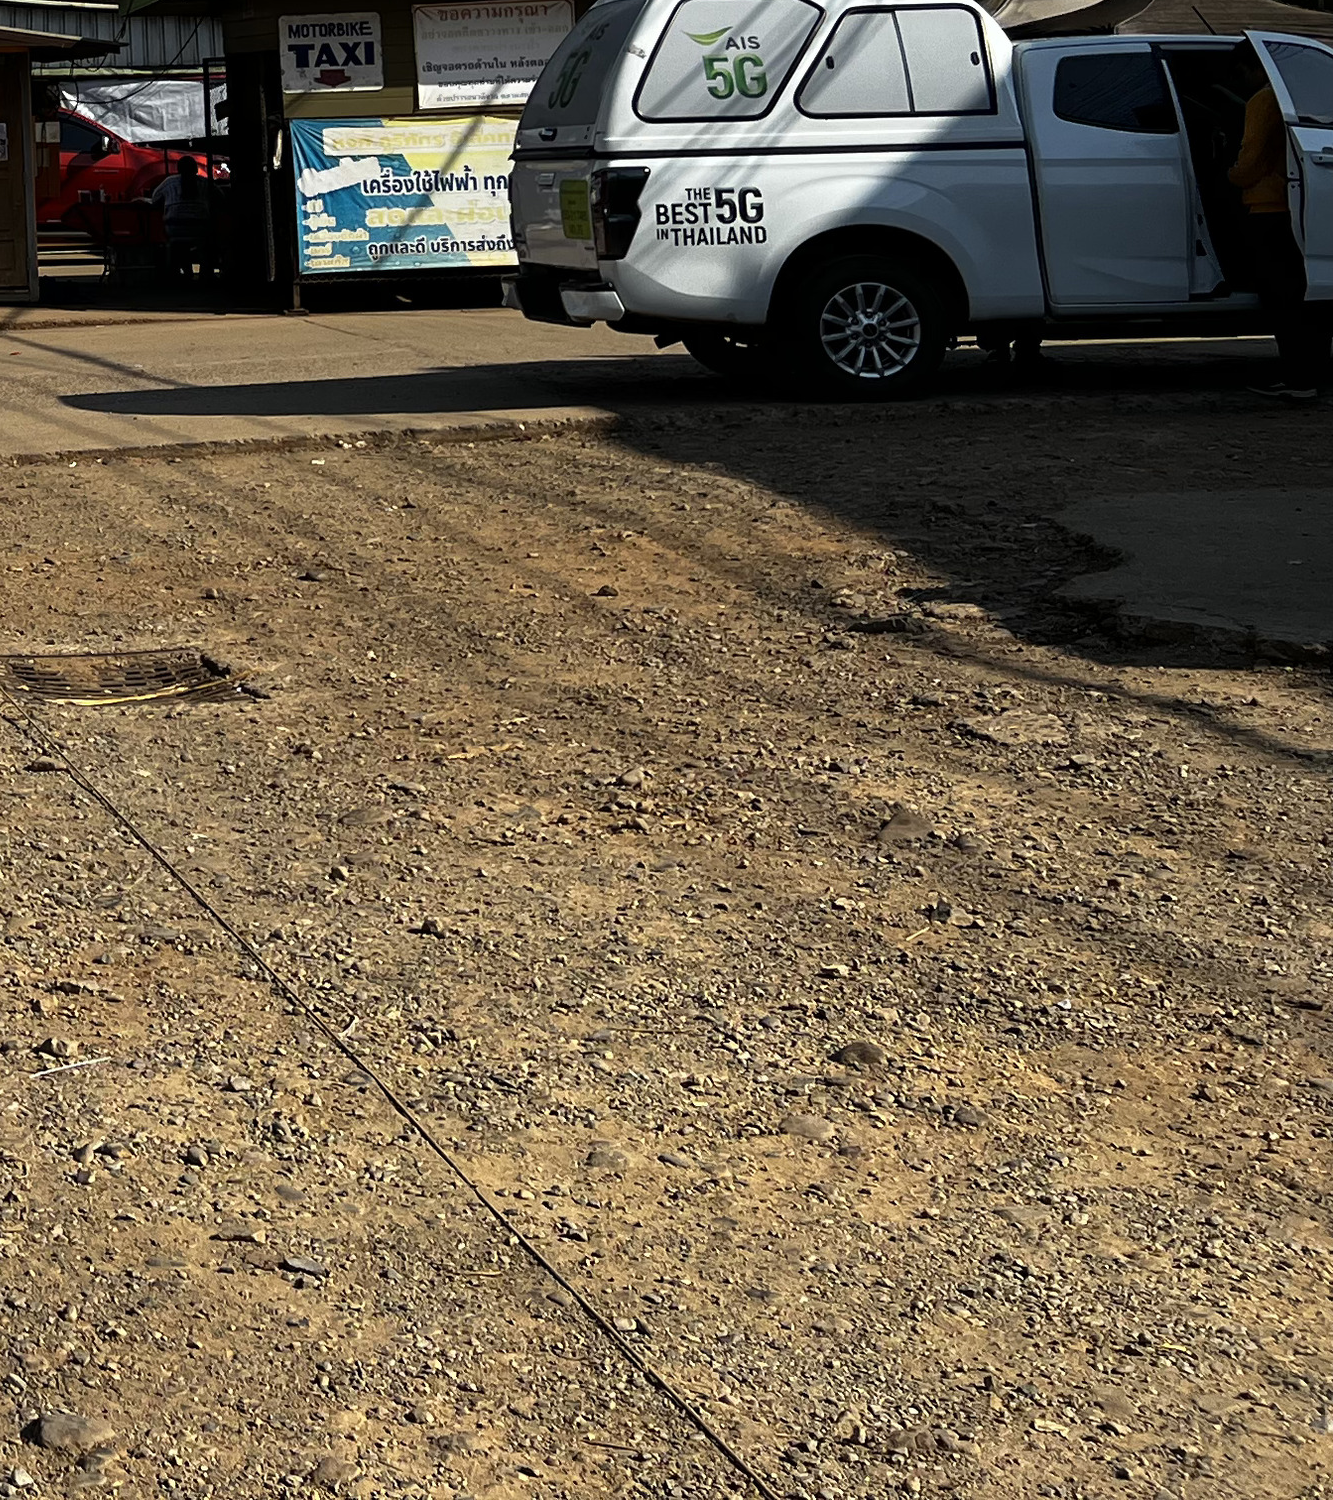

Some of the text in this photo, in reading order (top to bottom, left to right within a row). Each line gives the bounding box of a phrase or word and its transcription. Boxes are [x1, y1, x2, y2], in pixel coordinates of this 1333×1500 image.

[437, 4, 549, 24] ขอความกรุณา
[288, 21, 373, 39] MOTORBIKE
[725, 36, 761, 50] AIS
[288, 41, 375, 68] TAXI
[422, 57, 507, 74] เชิญจอดรถด้านใน
[702, 53, 768, 100] 5G
[363, 165, 478, 194] เครื่องใช้ไฟฟ้า
[685, 187, 711, 200] THE
[655, 186, 764, 225] BEST 5G
[656, 226, 767, 247] IN THAILAND
[368, 237, 425, 260] ถูกและดี
